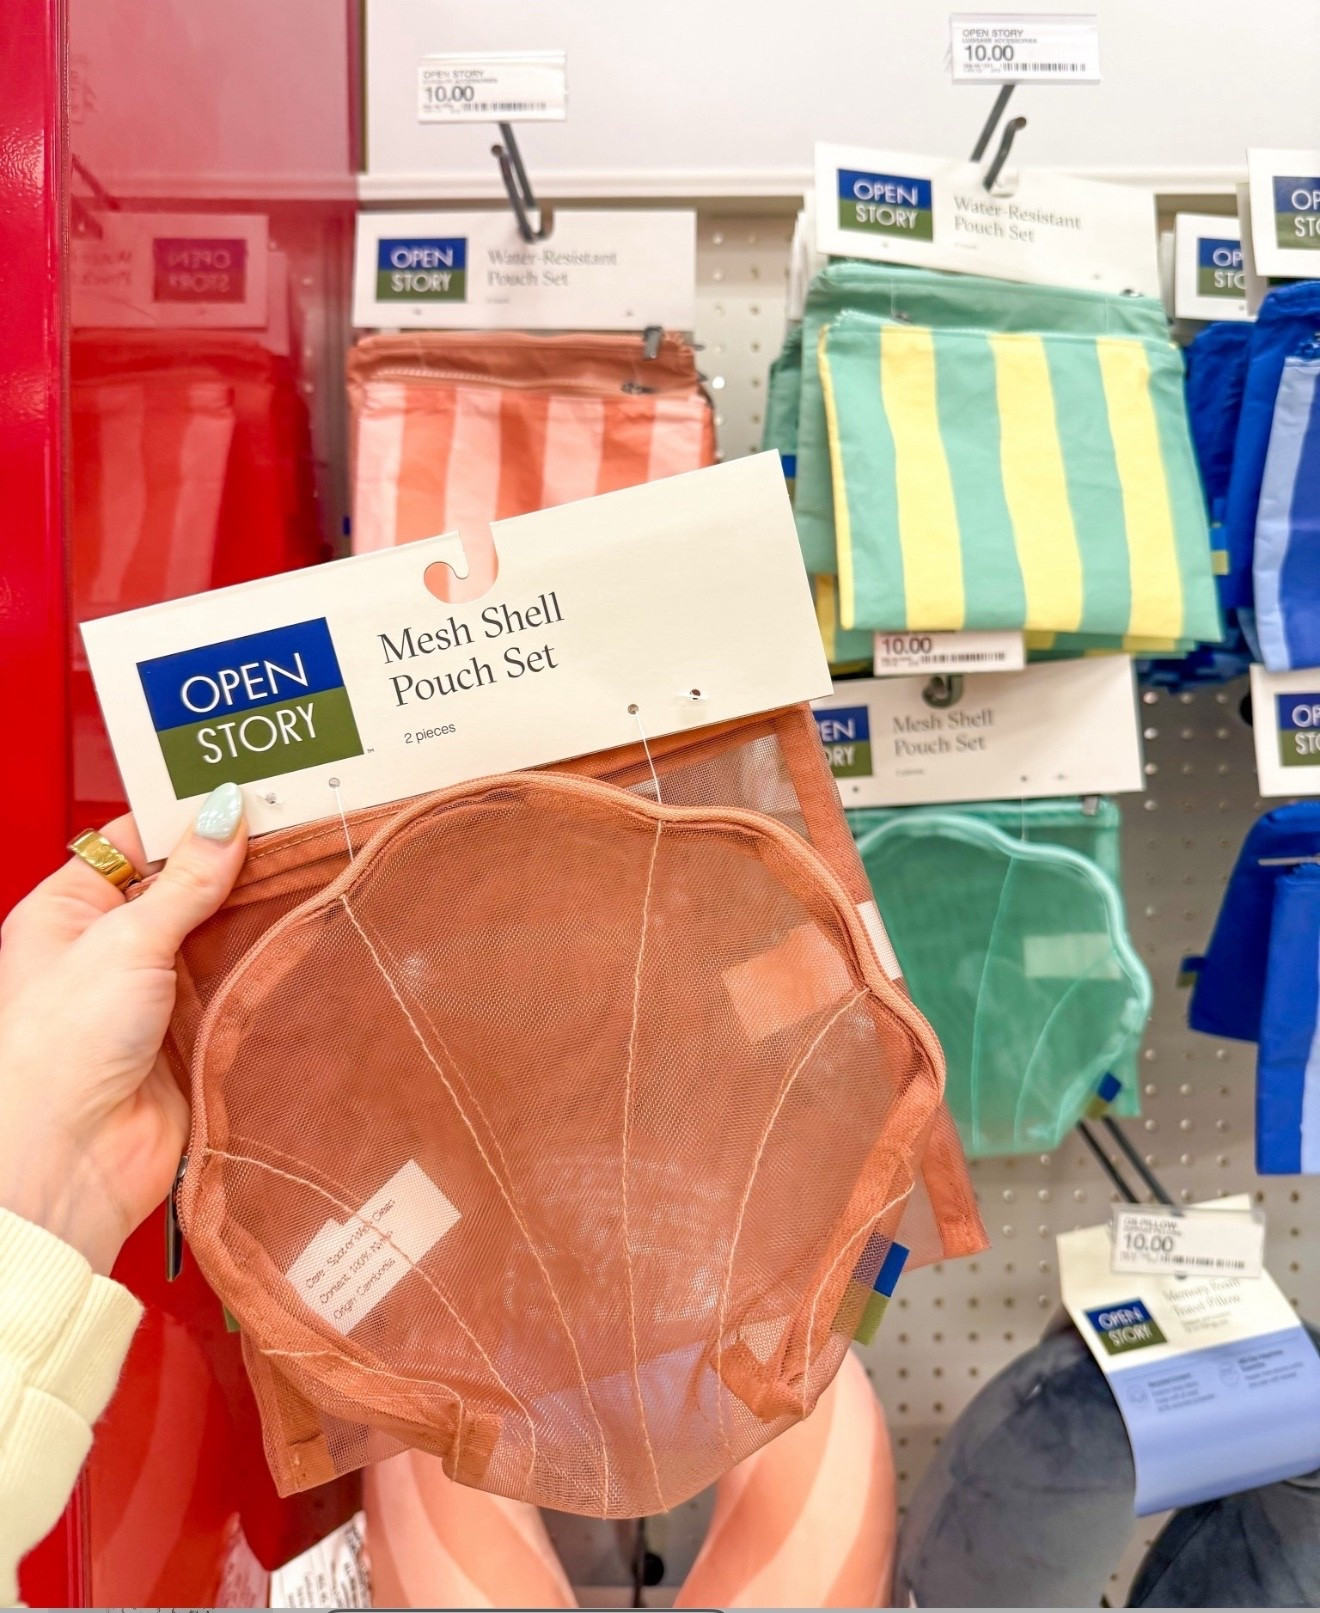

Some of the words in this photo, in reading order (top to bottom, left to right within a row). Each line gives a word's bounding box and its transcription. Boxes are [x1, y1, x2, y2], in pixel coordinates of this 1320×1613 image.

[962, 29, 989, 38] OPEN
[991, 29, 1024, 38] STORY
[964, 45, 1014, 61] 10.00
[424, 85, 475, 102] 10.00
[852, 178, 919, 206] OPEN
[855, 202, 918, 229] STORY
[953, 195, 1082, 229] Water-Resistant
[954, 215, 1004, 239] Pouch
[1008, 225, 1036, 243] Set
[389, 247, 454, 269] OPEN
[391, 271, 453, 293] STORY
[377, 616, 475, 665] Mesh
[481, 591, 565, 639] Shell
[880, 636, 932, 654] 10.00
[180, 652, 309, 714] OPEN
[388, 656, 498, 707] Pouch
[503, 643, 559, 679] Set
[892, 713, 943, 734] Mesh
[947, 708, 995, 728] Shell
[196, 702, 318, 765] STORY
[404, 732, 413, 744] 2
[415, 723, 456, 743] pieces
[894, 736, 951, 757] Pouch
[955, 733, 985, 752] Set
[1125, 1234, 1174, 1252] 10.00
[1098, 1306, 1145, 1329] OPEN
[1108, 1324, 1155, 1347] STORY
